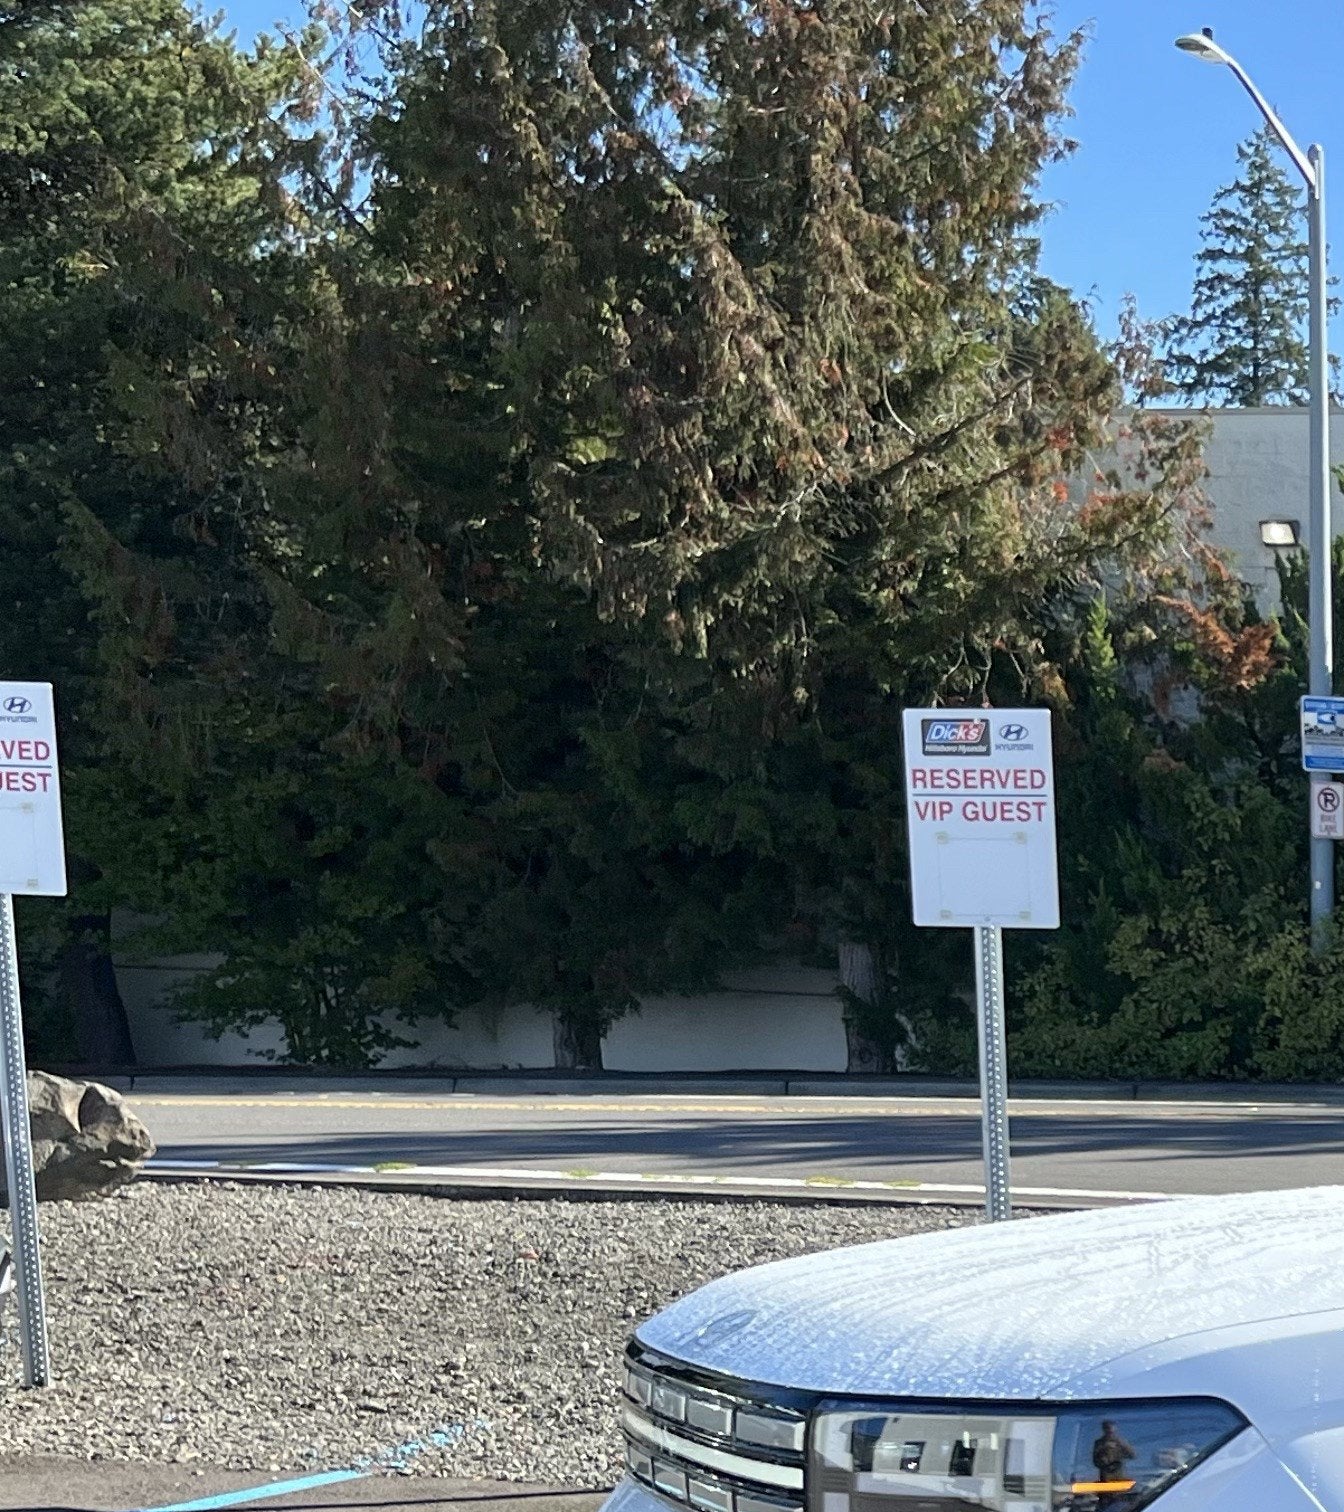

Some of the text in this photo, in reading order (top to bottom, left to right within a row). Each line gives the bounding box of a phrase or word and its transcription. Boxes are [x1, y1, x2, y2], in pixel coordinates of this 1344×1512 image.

[930, 722, 980, 741] Dick's
[0, 740, 50, 761] VED
[0, 771, 51, 793] EST
[911, 768, 1046, 789] RESERVED
[915, 800, 1047, 822] VIP GUEST
